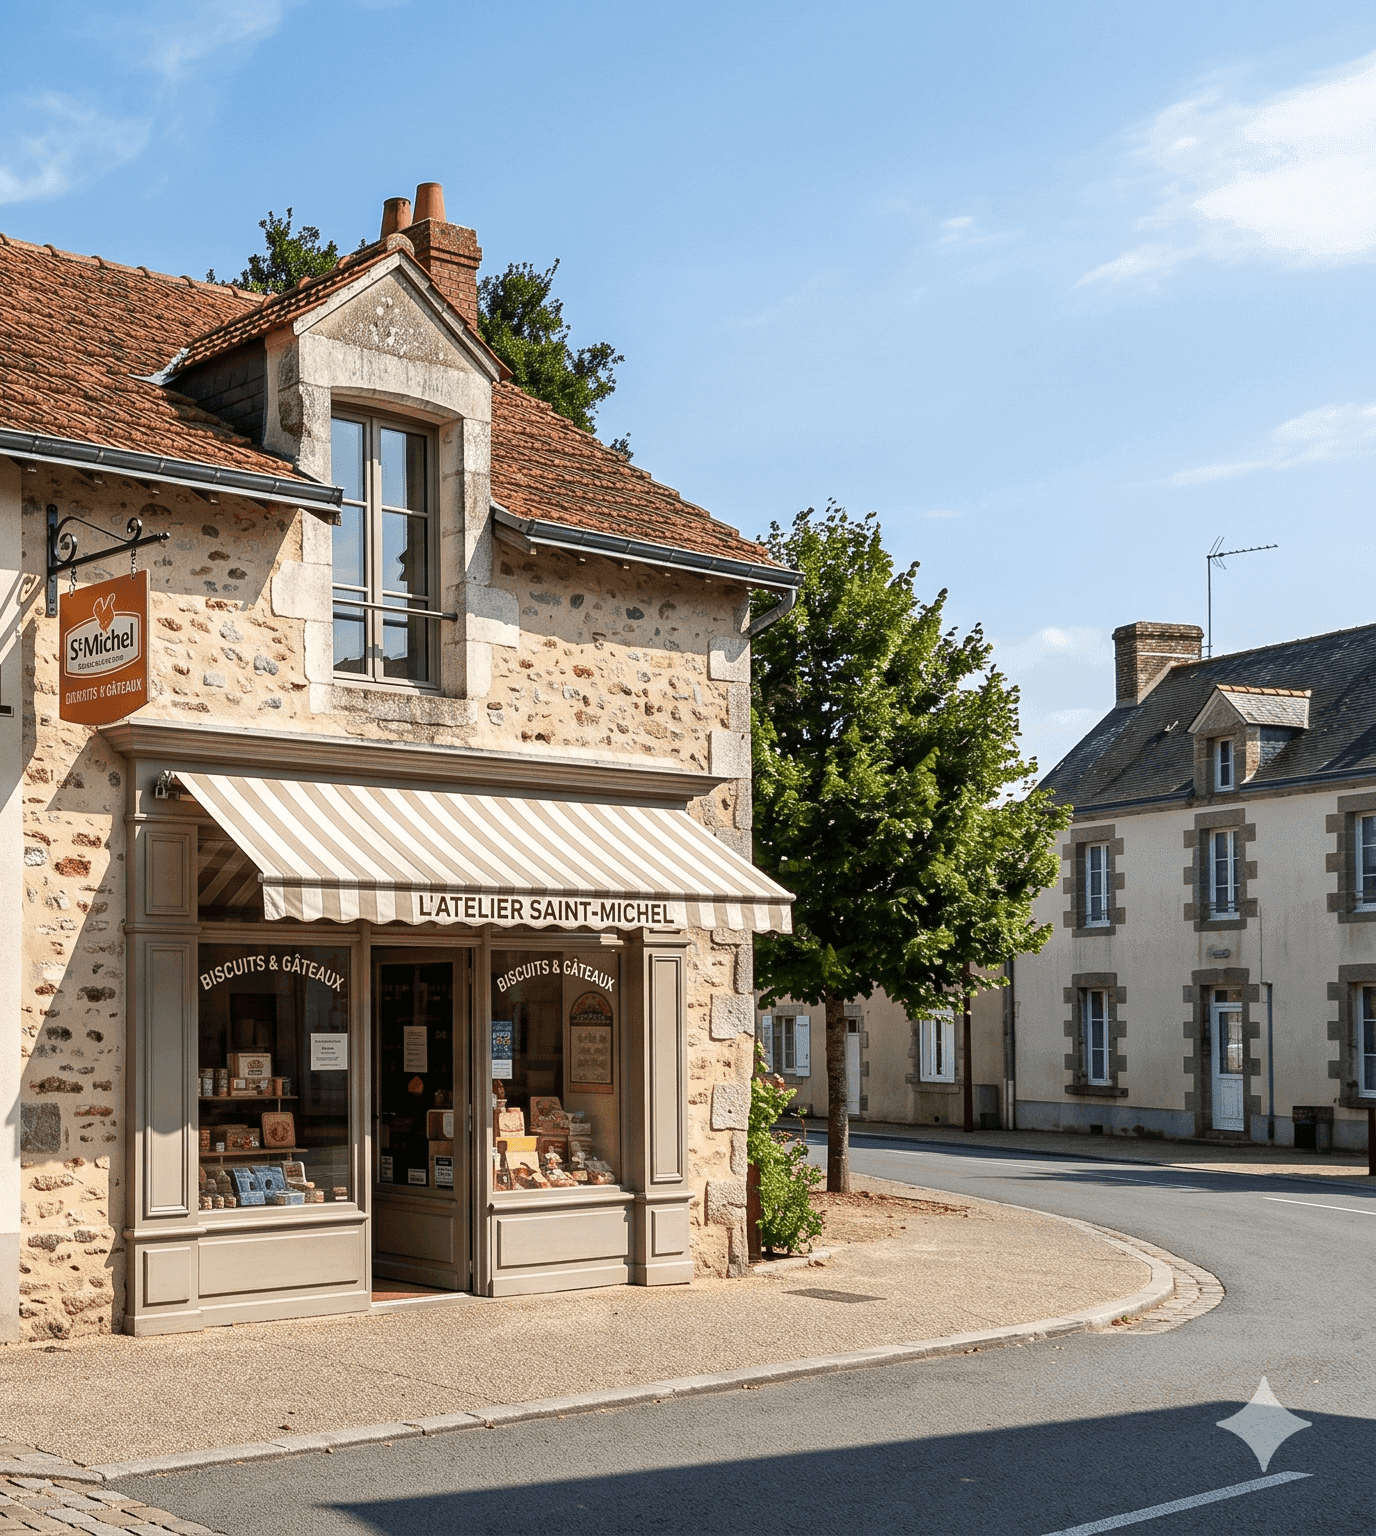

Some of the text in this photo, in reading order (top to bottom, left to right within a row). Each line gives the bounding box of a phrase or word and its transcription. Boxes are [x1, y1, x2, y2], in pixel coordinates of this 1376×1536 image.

[419, 894, 675, 924] L'ATELIER SAINT-MICHEL
[199, 953, 345, 992] BISCUITS & GÂTEAUX
[497, 958, 615, 993] BISCUITS & GÂTEAUX
